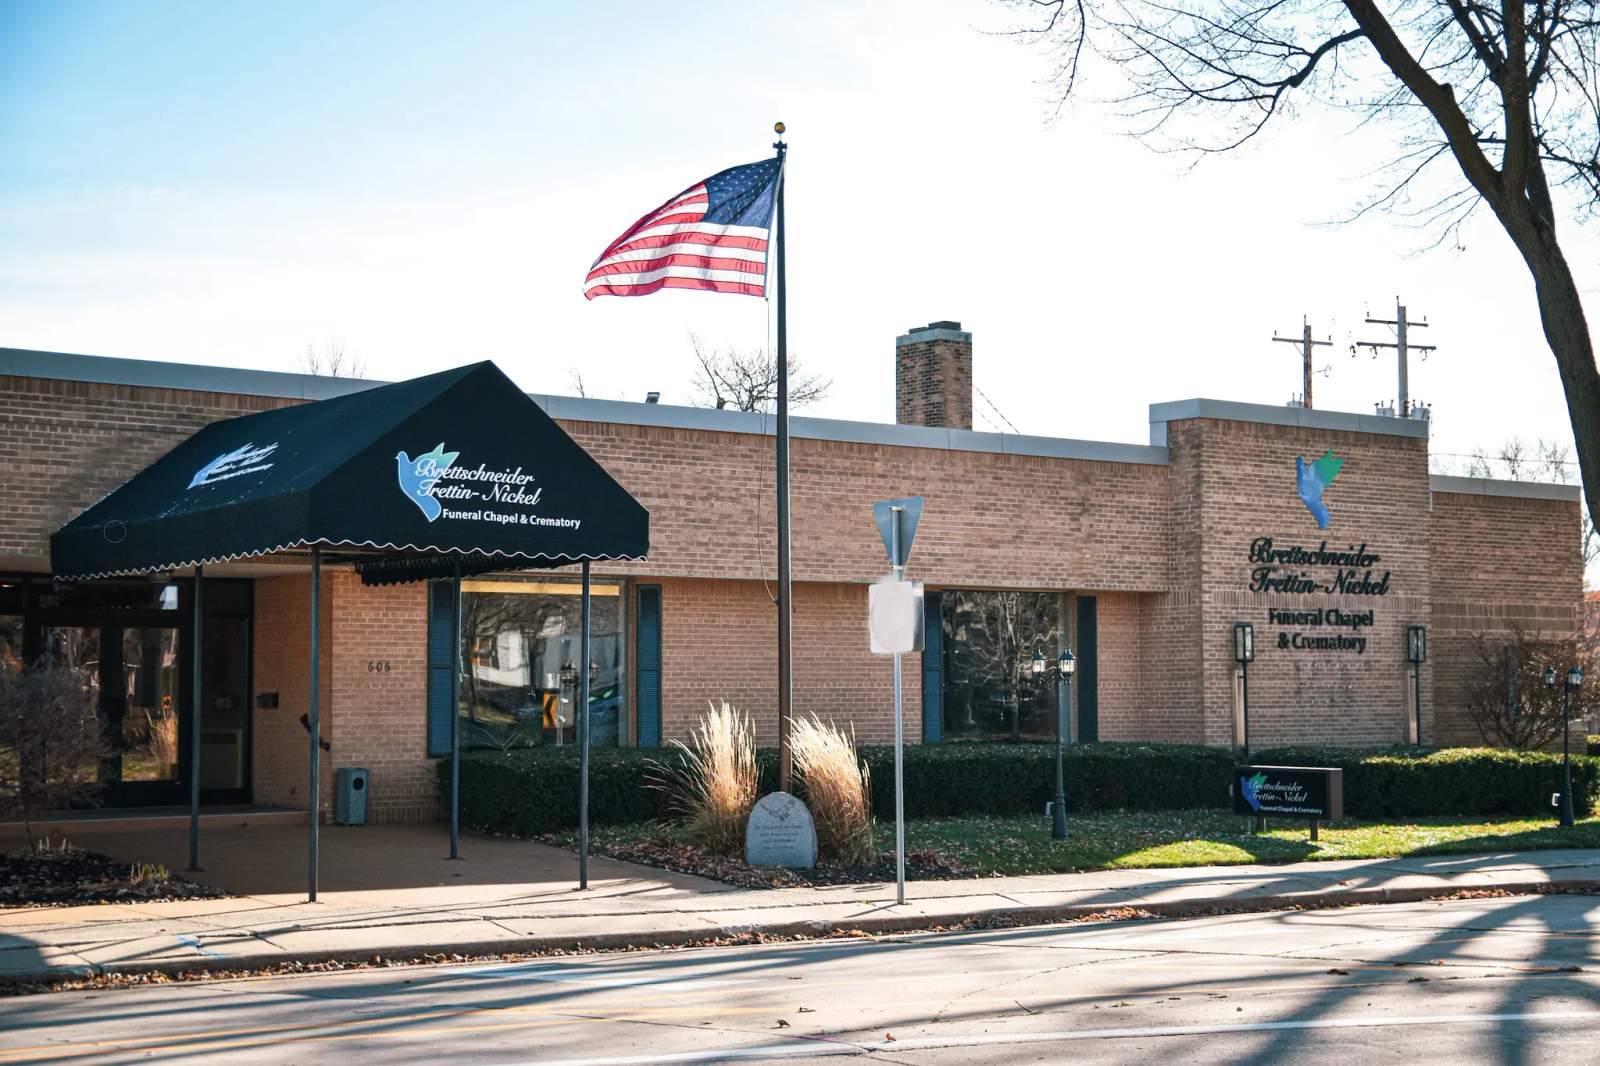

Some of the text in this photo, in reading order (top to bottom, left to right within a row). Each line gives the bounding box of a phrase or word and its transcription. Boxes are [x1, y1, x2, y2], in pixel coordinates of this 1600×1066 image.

[415, 458, 535, 485] Brettschneider
[443, 508, 580, 530] Funeral Chapel & Crematory
[1248, 537, 1381, 567] Brettschneider
[1269, 608, 1374, 630] Funeral Chapel
[1277, 632, 1366, 654] & Crematory
[367, 660, 391, 672] 606
